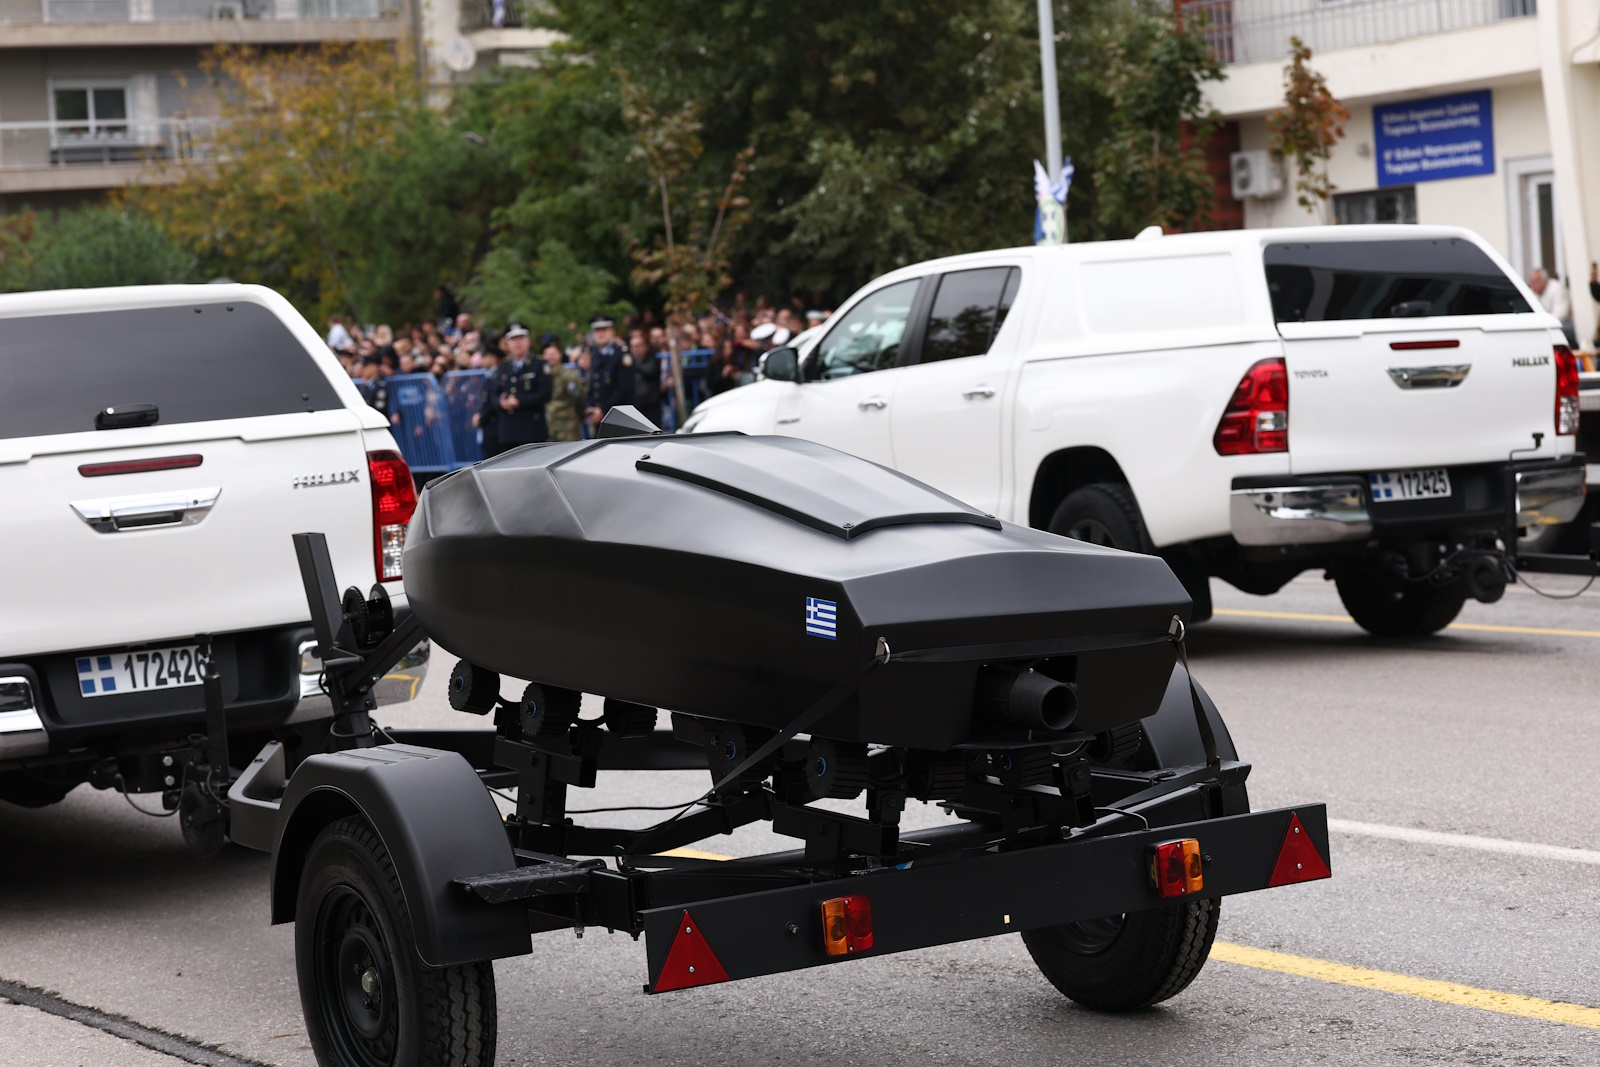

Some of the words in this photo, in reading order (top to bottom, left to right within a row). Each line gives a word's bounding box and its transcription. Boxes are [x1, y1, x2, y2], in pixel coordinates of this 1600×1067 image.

[1512, 355, 1549, 368] HILUX
[1293, 369, 1329, 380] TOYOTA
[1397, 469, 1448, 497] 172425
[124, 647, 209, 689] 172426
